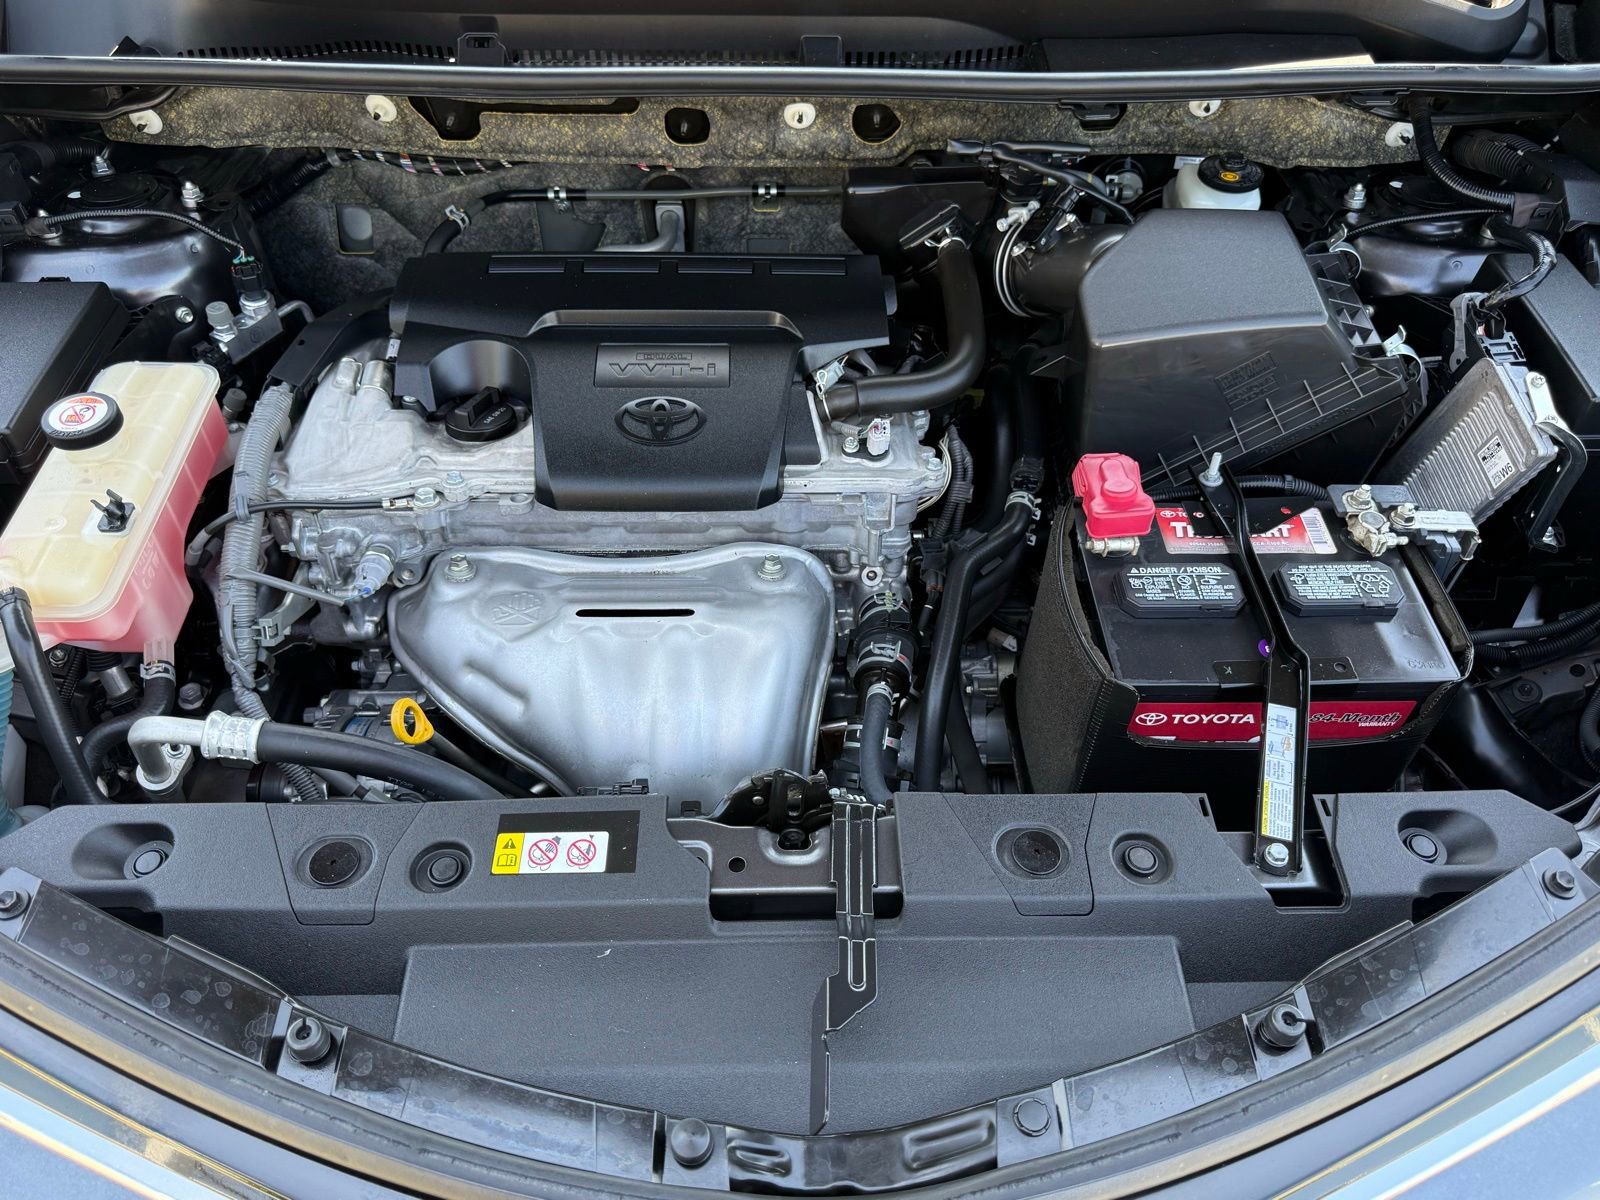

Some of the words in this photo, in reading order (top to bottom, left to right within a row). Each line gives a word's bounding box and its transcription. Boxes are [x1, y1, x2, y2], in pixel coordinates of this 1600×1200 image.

[609, 362, 716, 378] VVT-i
[1499, 462, 1513, 478] W6
[1172, 714, 1256, 724] TOYOTA
[1310, 712, 1402, 723] 84-Month
